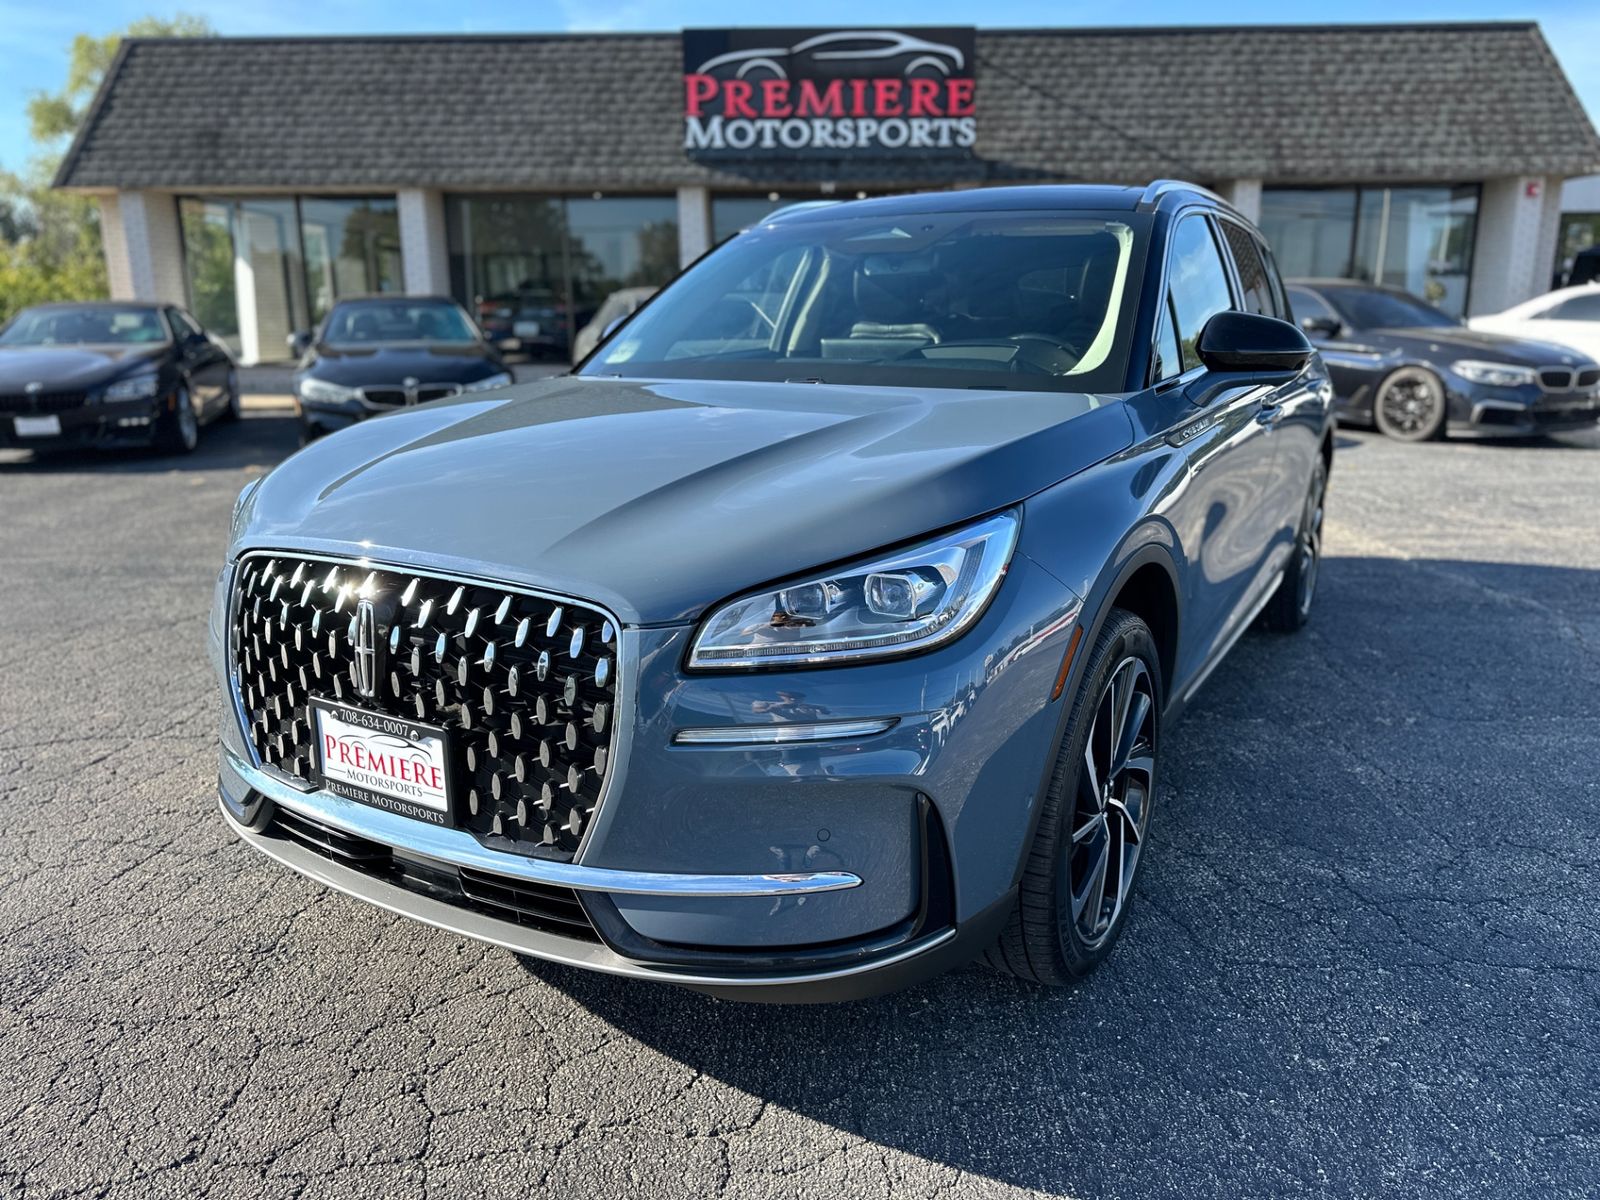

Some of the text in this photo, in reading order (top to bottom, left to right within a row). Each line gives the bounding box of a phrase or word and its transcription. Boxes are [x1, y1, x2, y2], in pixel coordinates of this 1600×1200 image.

[683, 74, 976, 118] PREMIERE
[683, 115, 977, 149] MOTORSPORTS
[340, 709, 408, 736] 708-634-0007
[325, 734, 443, 790] PREMIERE
[325, 780, 445, 824] PREMIERE MOTORSPORTS
[346, 769, 424, 798] MOTORSPORTS
